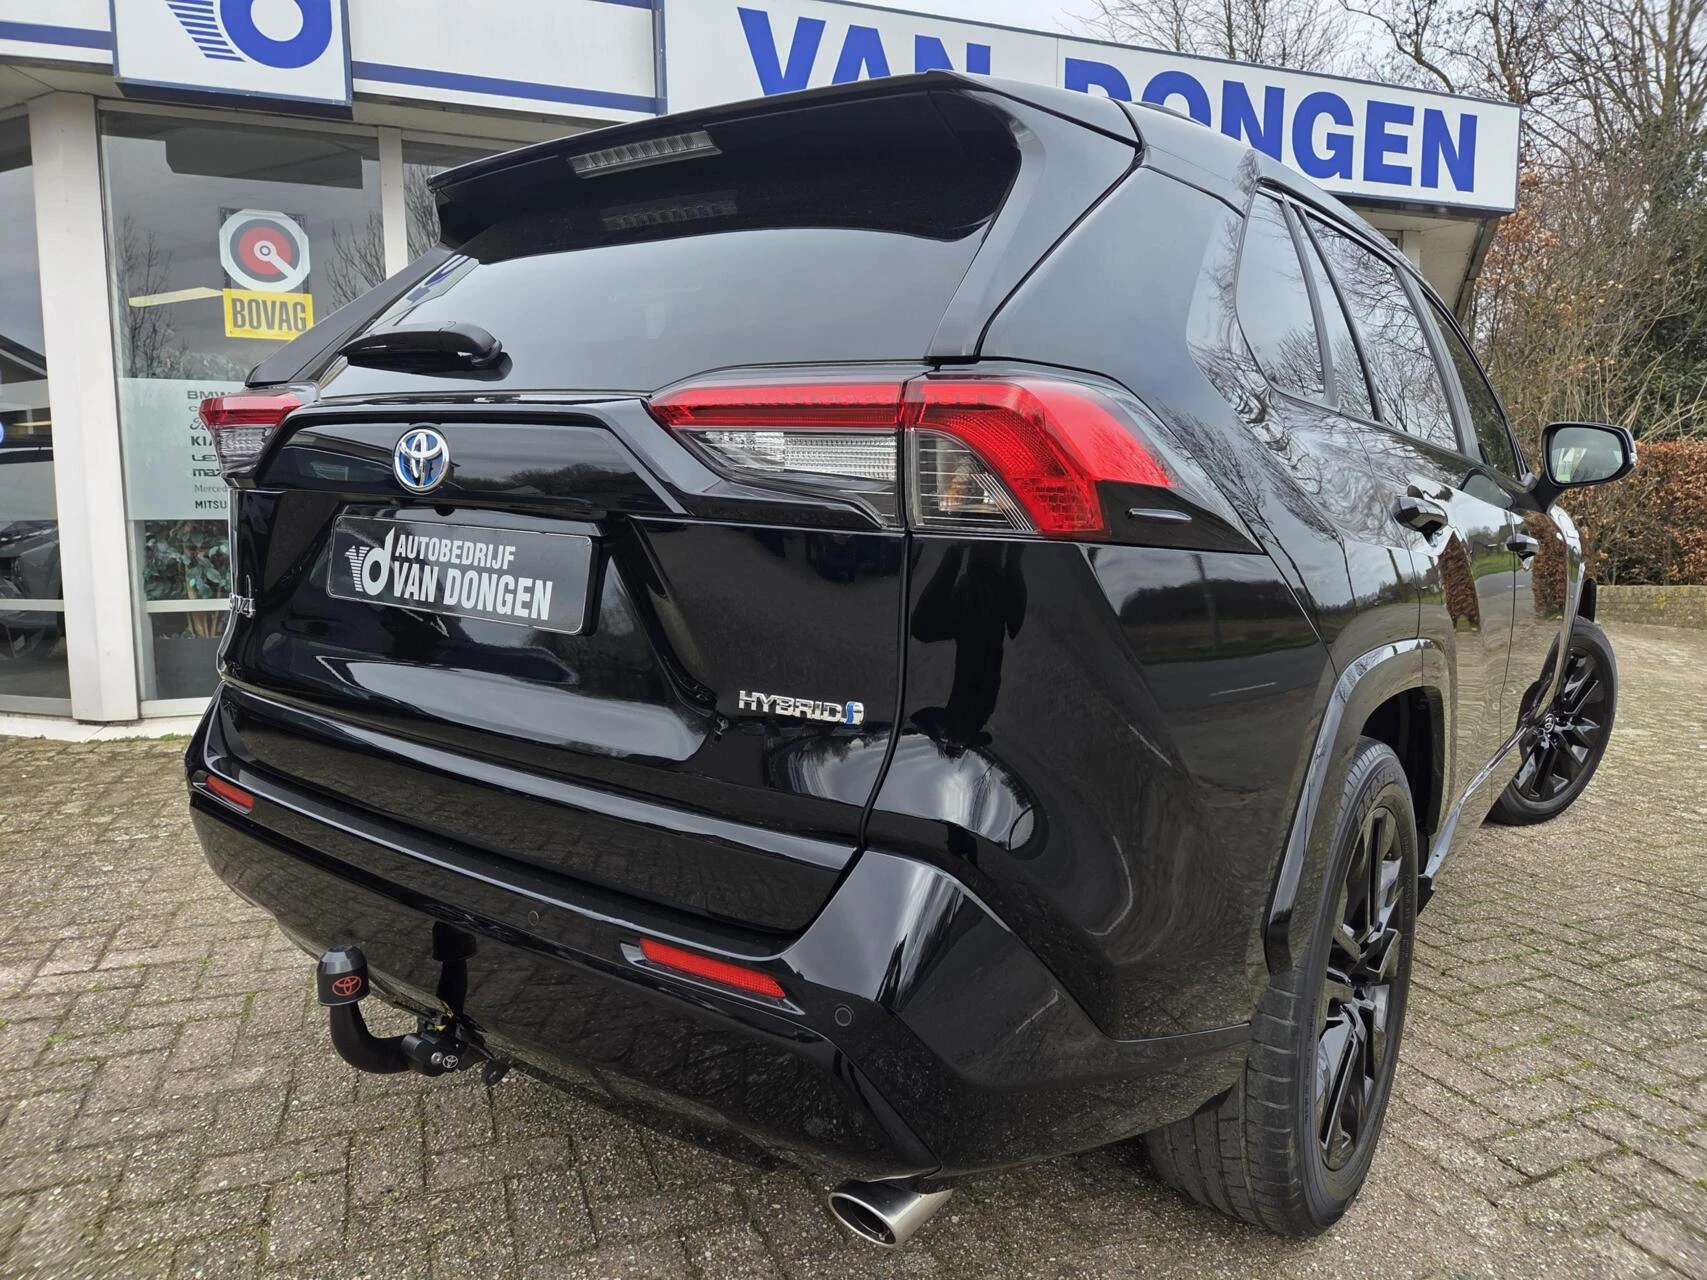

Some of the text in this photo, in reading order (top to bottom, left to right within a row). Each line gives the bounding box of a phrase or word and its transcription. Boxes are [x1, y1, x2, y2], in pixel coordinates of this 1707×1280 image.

[231, 298, 307, 332] BOVAG
[191, 436, 213, 446] KI
[395, 534, 515, 570] AUTOBEDRIJF
[393, 561, 552, 620] VAN DONGEN
[738, 690, 843, 722] HYBRID
